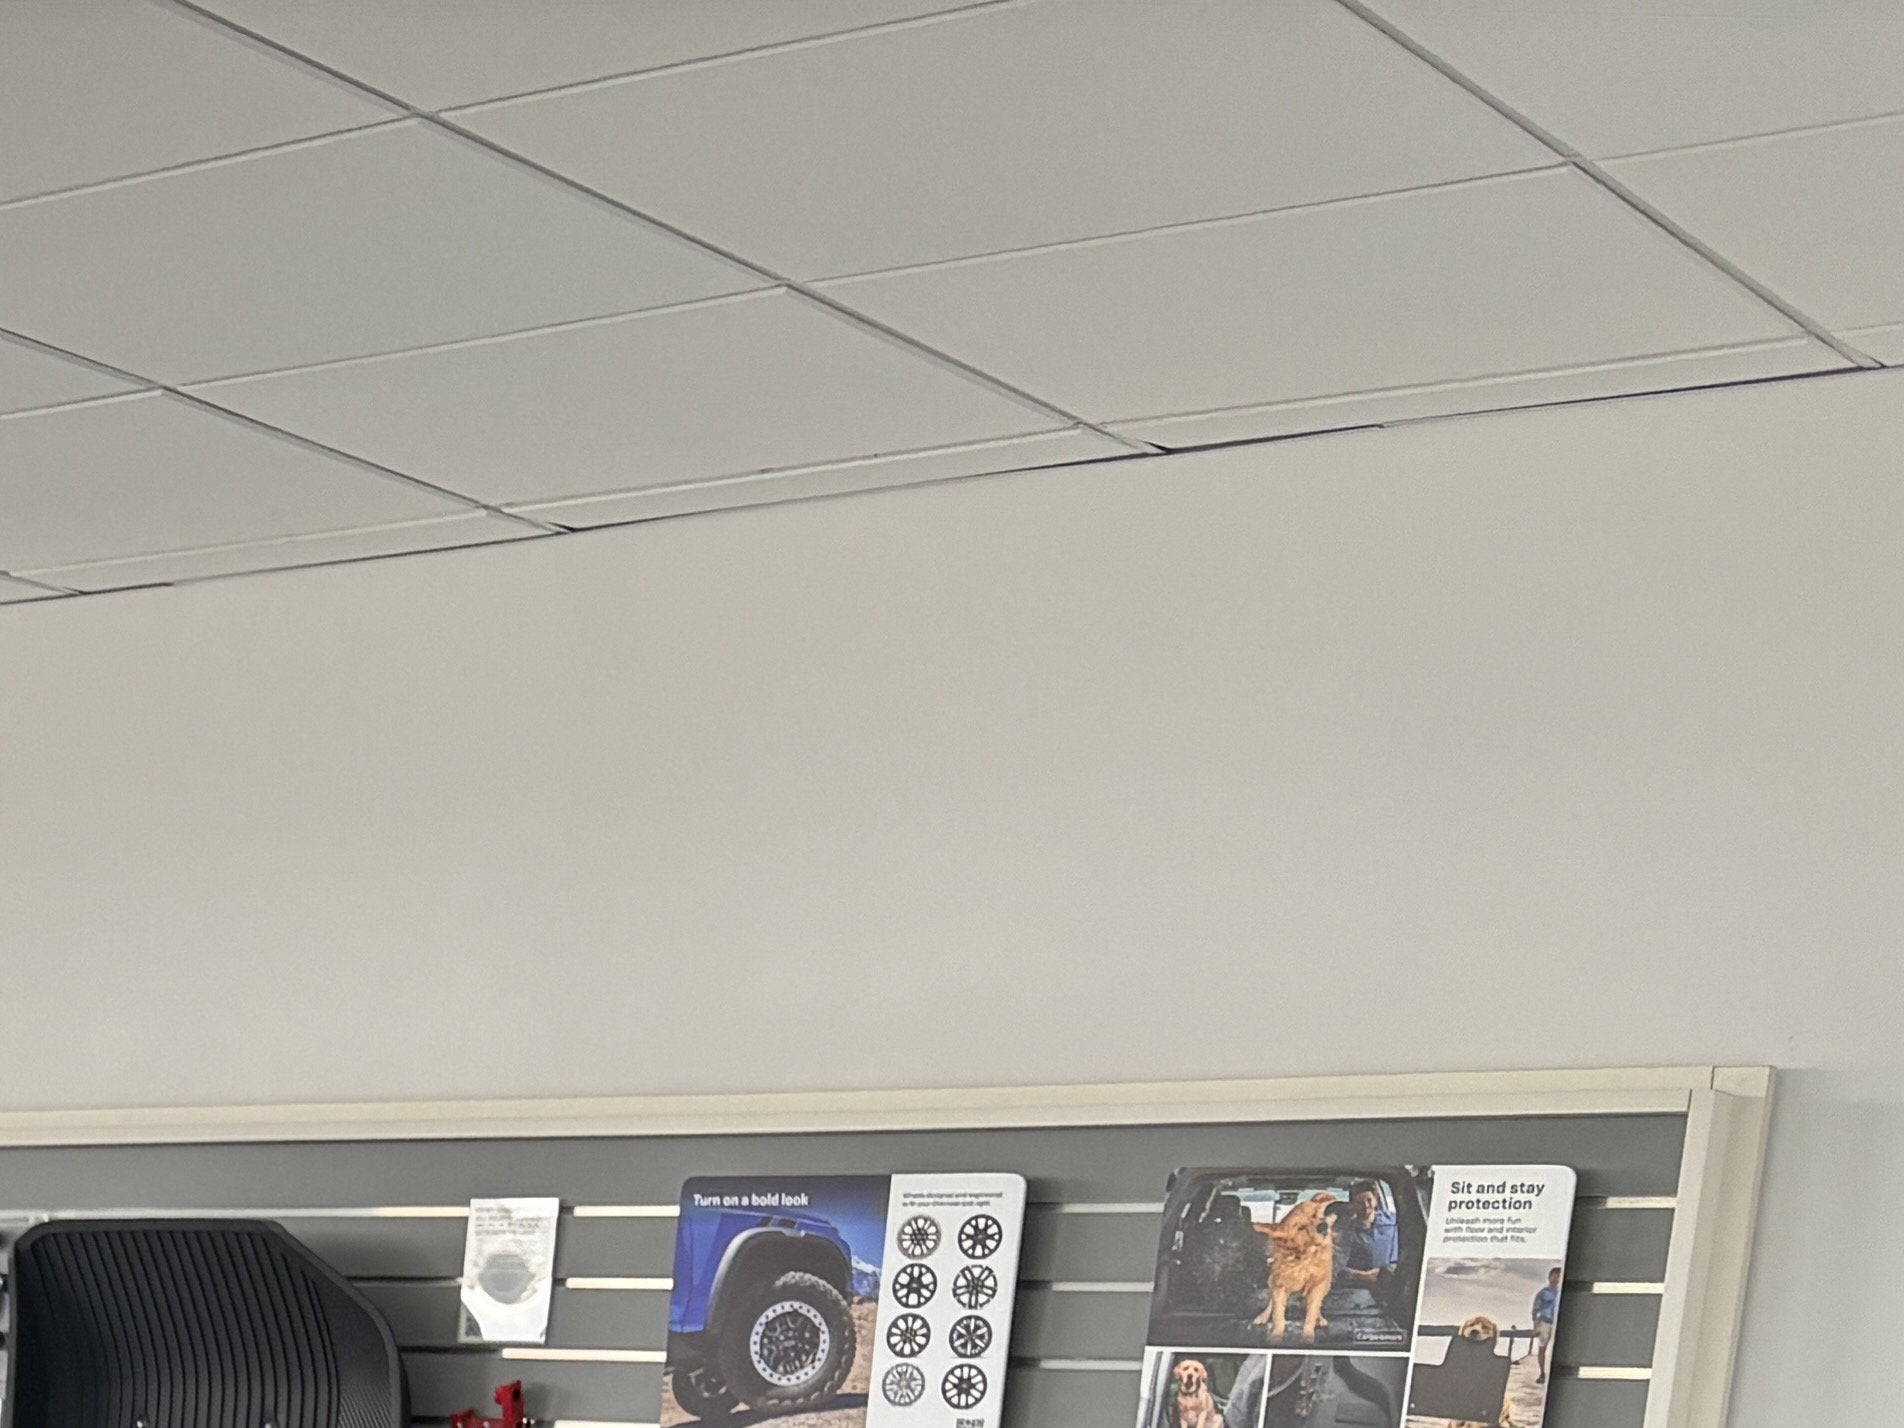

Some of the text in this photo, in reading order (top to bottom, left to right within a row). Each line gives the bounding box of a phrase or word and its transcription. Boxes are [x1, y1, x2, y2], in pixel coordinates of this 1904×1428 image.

[1450, 1180, 1545, 1197] Sit and stay
[693, 1192, 809, 1206] Turn on a bold look
[1448, 1197, 1533, 1212] protection
[1445, 1216, 1522, 1225] Unleash more fun
[1444, 1225, 1537, 1234] with floor and interior
[1442, 1235, 1488, 1244] protection
[1490, 1235, 1508, 1243] that
